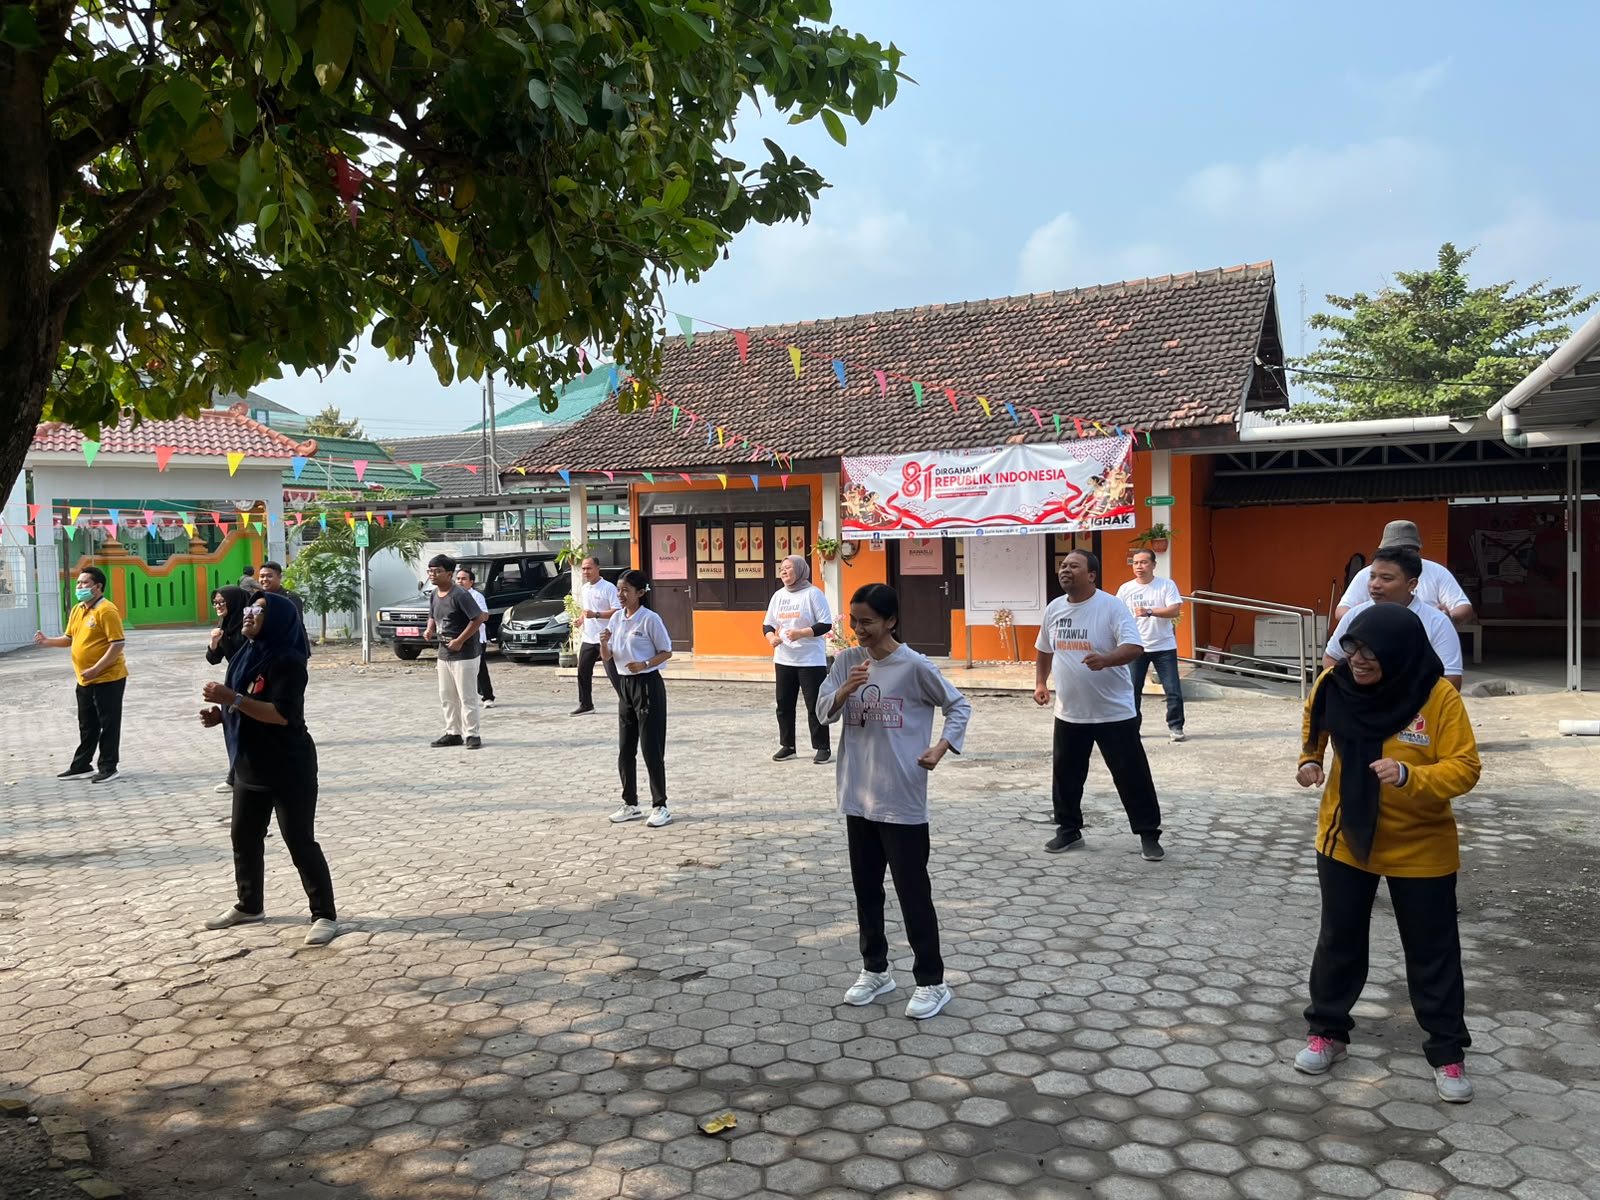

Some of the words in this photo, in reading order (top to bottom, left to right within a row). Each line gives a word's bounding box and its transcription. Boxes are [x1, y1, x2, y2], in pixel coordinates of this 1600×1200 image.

[902, 461, 937, 502] 81
[935, 473, 993, 488] REPUBLIK
[996, 469, 1066, 484] INDONESIA
[1059, 618, 1072, 628] AYO
[1057, 629, 1088, 640] NYAWIJI
